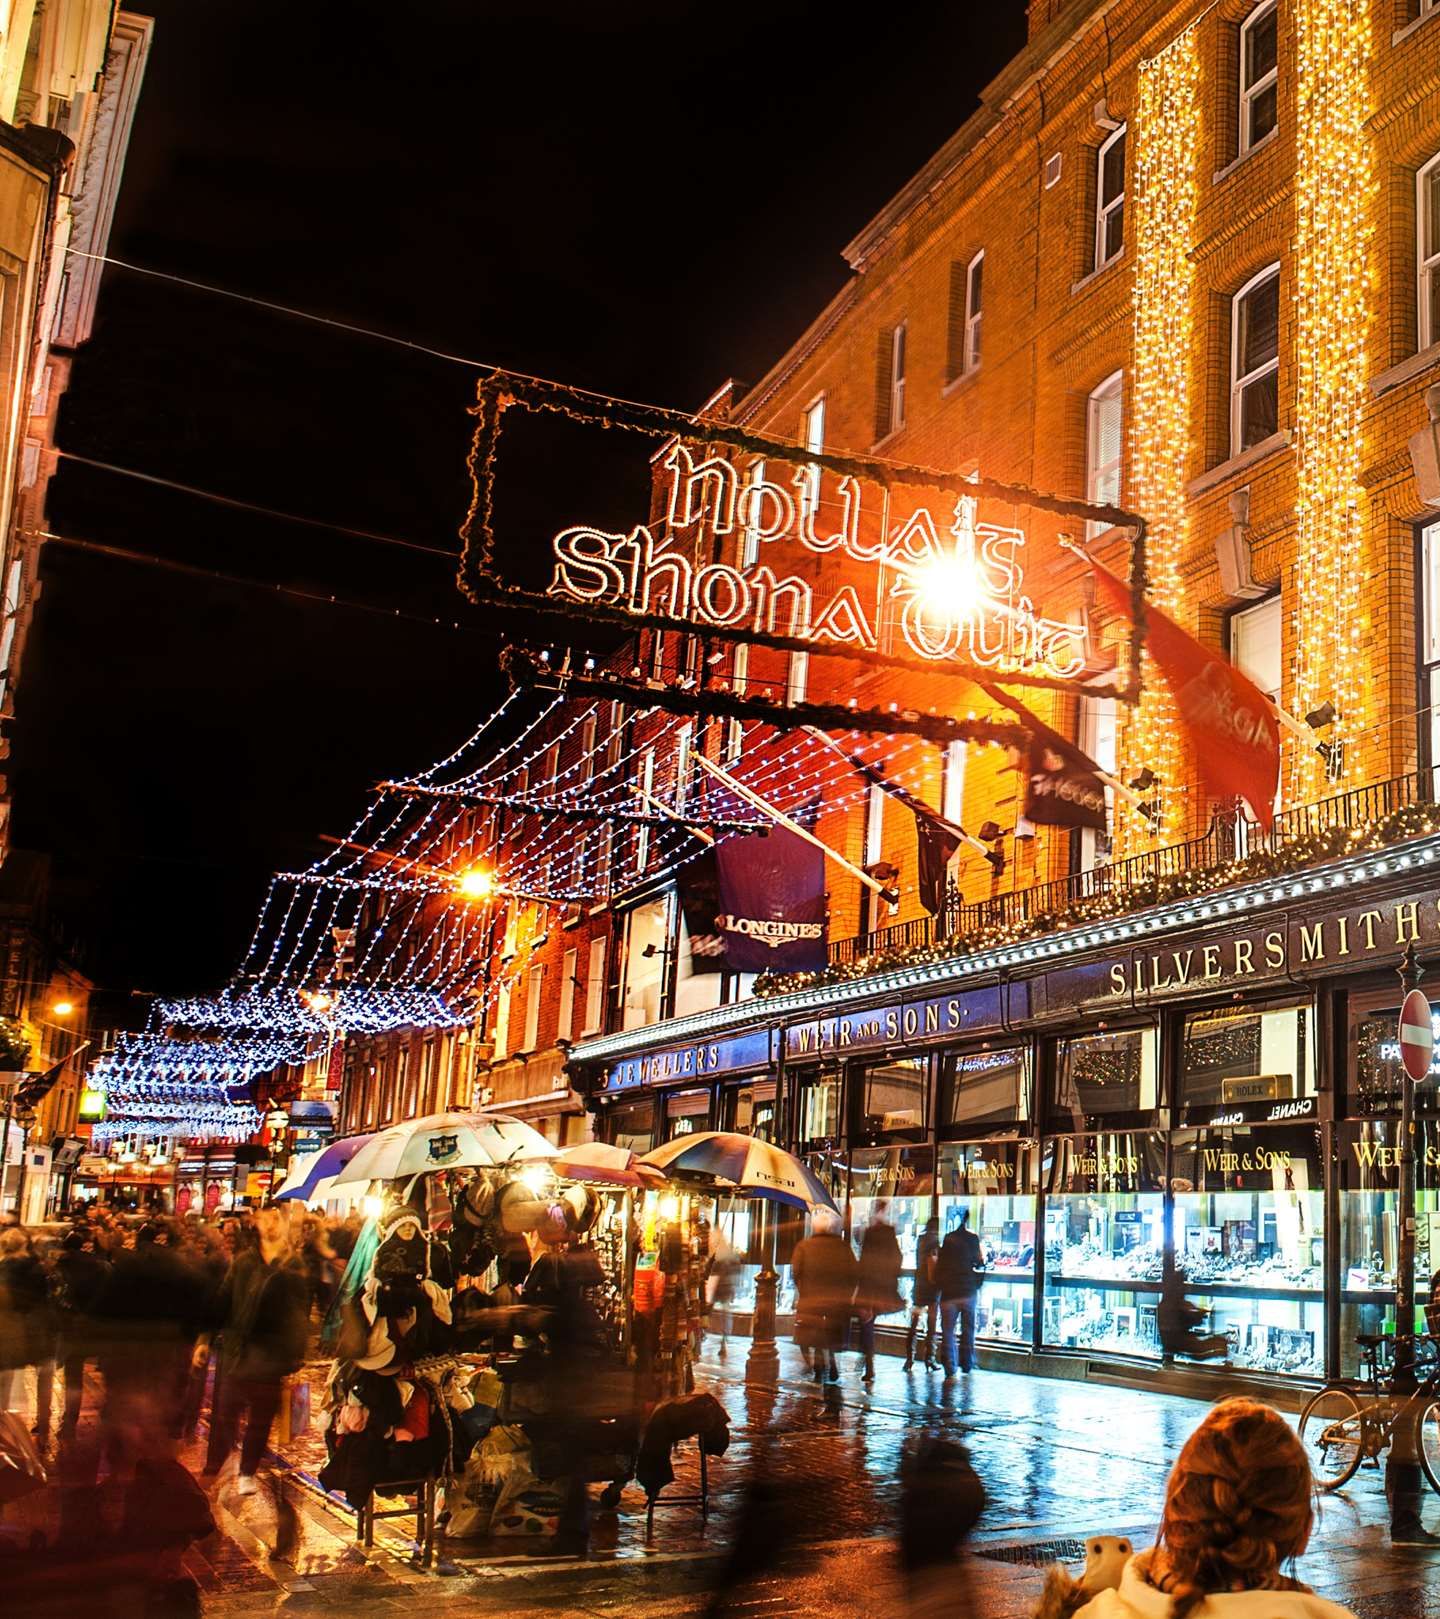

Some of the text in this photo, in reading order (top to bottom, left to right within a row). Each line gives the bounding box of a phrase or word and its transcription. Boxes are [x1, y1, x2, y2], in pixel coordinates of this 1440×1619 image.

[548, 526, 878, 648] Shona
[725, 915, 823, 939] LONGINES
[799, 1020, 851, 1052] WEIR
[857, 1021, 879, 1038] AND
[617, 1046, 720, 1085] JEWELLERS
[1071, 1154, 1097, 1175] WEIR
[1098, 1159, 1107, 1174] &
[1204, 1146, 1290, 1171] WEIR & SONS
[1352, 1141, 1404, 1167] WEI
[990, 1159, 1014, 1179] SONS
